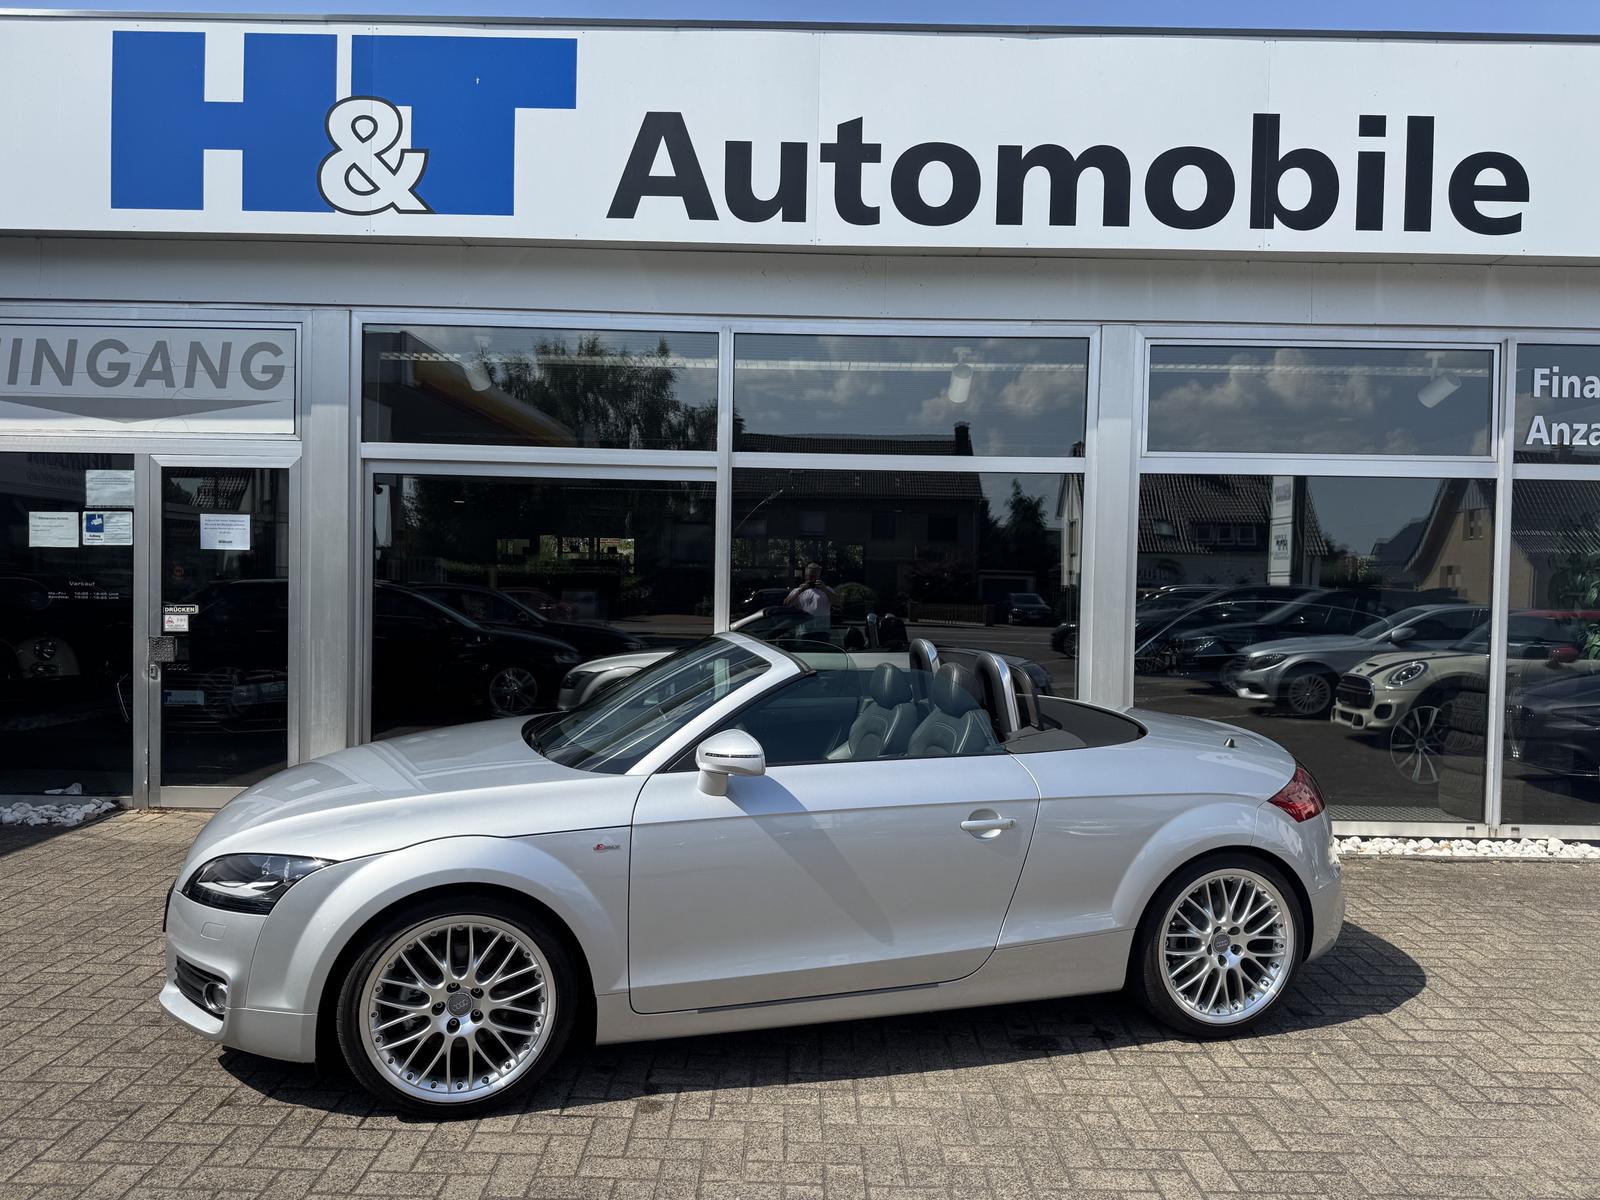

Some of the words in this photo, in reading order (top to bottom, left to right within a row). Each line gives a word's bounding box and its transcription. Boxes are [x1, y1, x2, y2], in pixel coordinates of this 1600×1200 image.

[111, 30, 577, 217] H&T
[607, 112, 1530, 235] Automobile
[0, 338, 285, 391] INGANG
[1533, 366, 1600, 398] Fina
[1525, 415, 1600, 446] Anza
